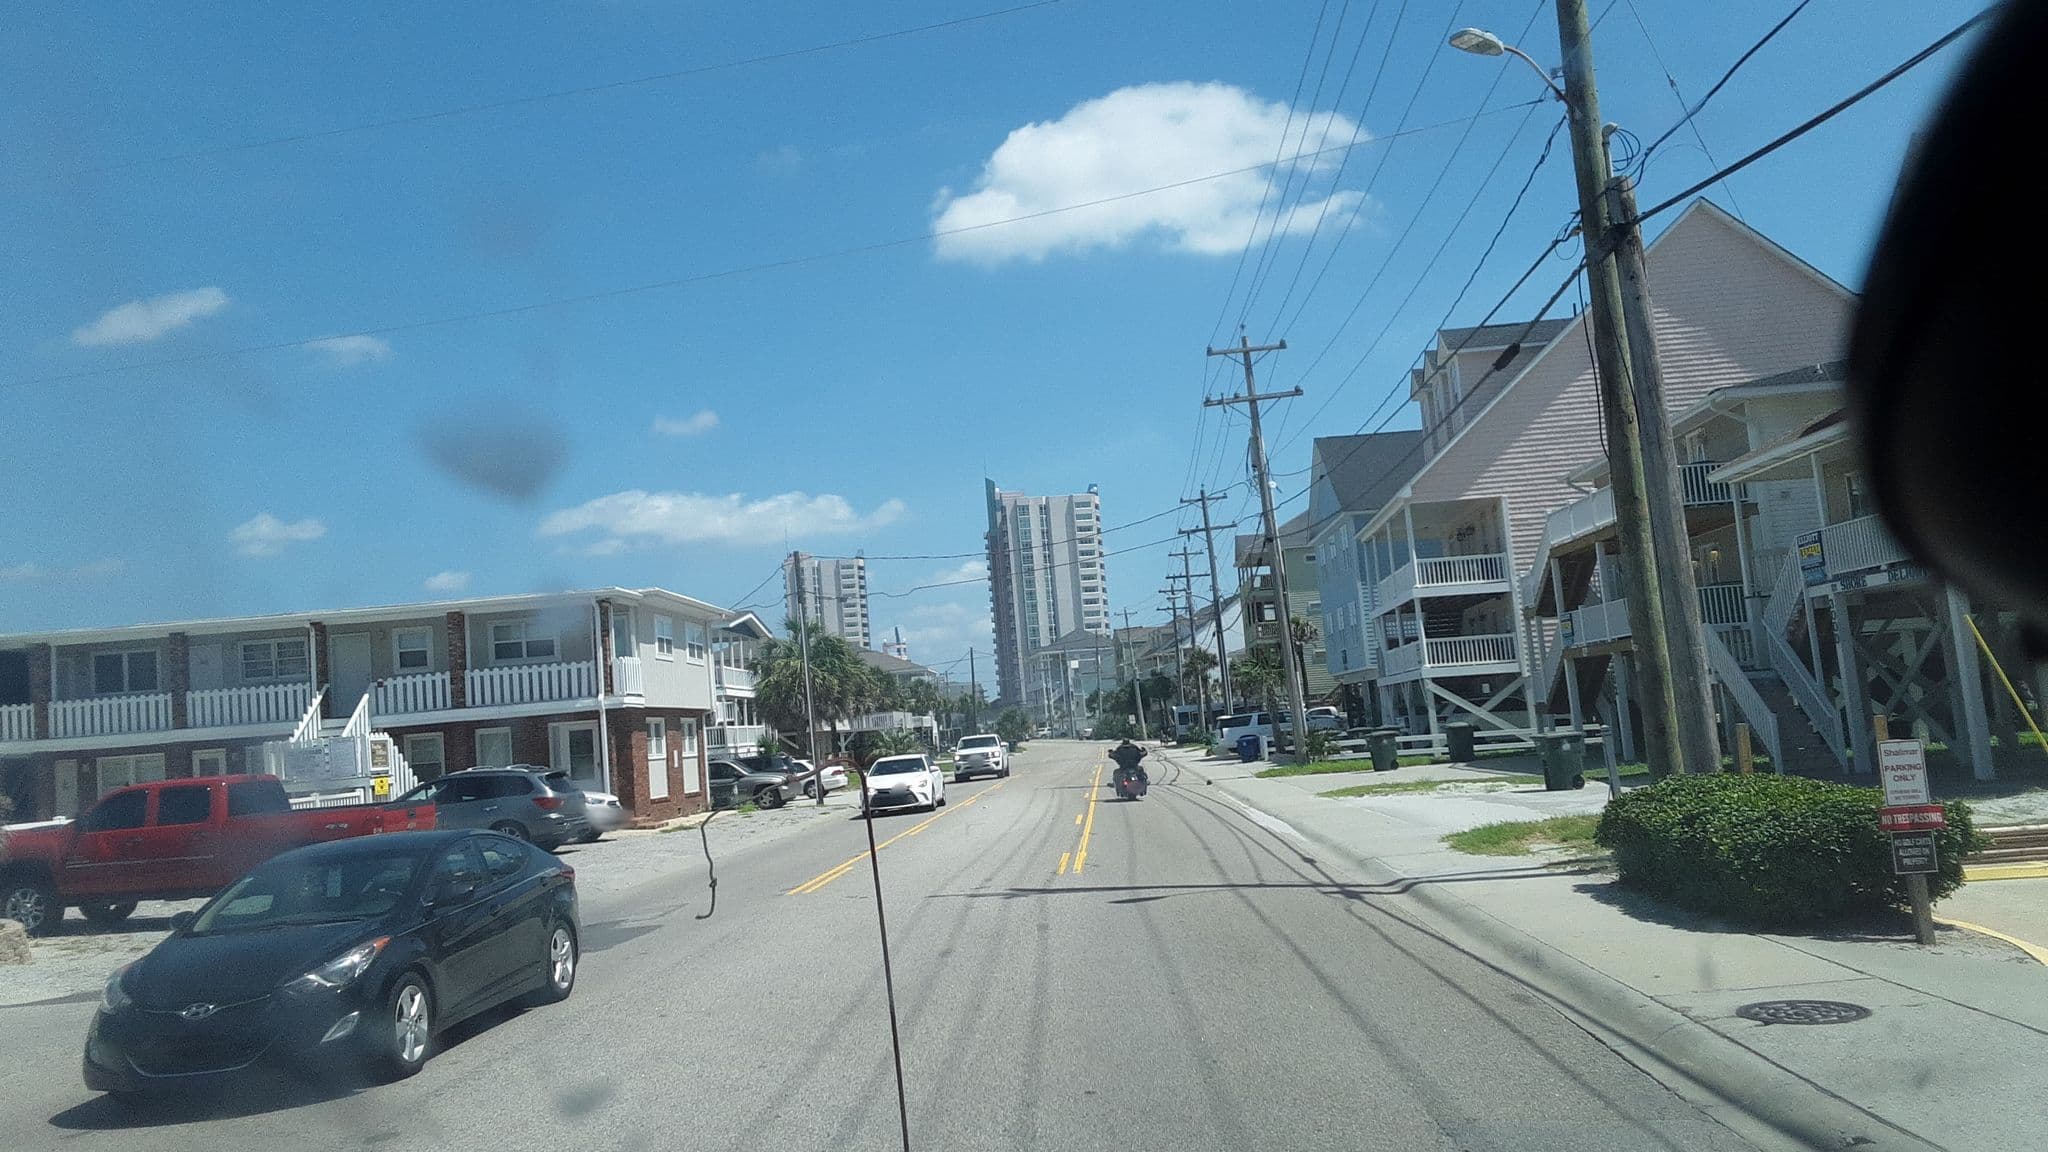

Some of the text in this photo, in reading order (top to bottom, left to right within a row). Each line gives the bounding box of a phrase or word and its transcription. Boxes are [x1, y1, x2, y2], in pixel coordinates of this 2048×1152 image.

[1884, 763, 1922, 772] PARKING
[1893, 774, 1916, 782] ONLY
[1881, 812, 1943, 825] NO TRESPASSING
